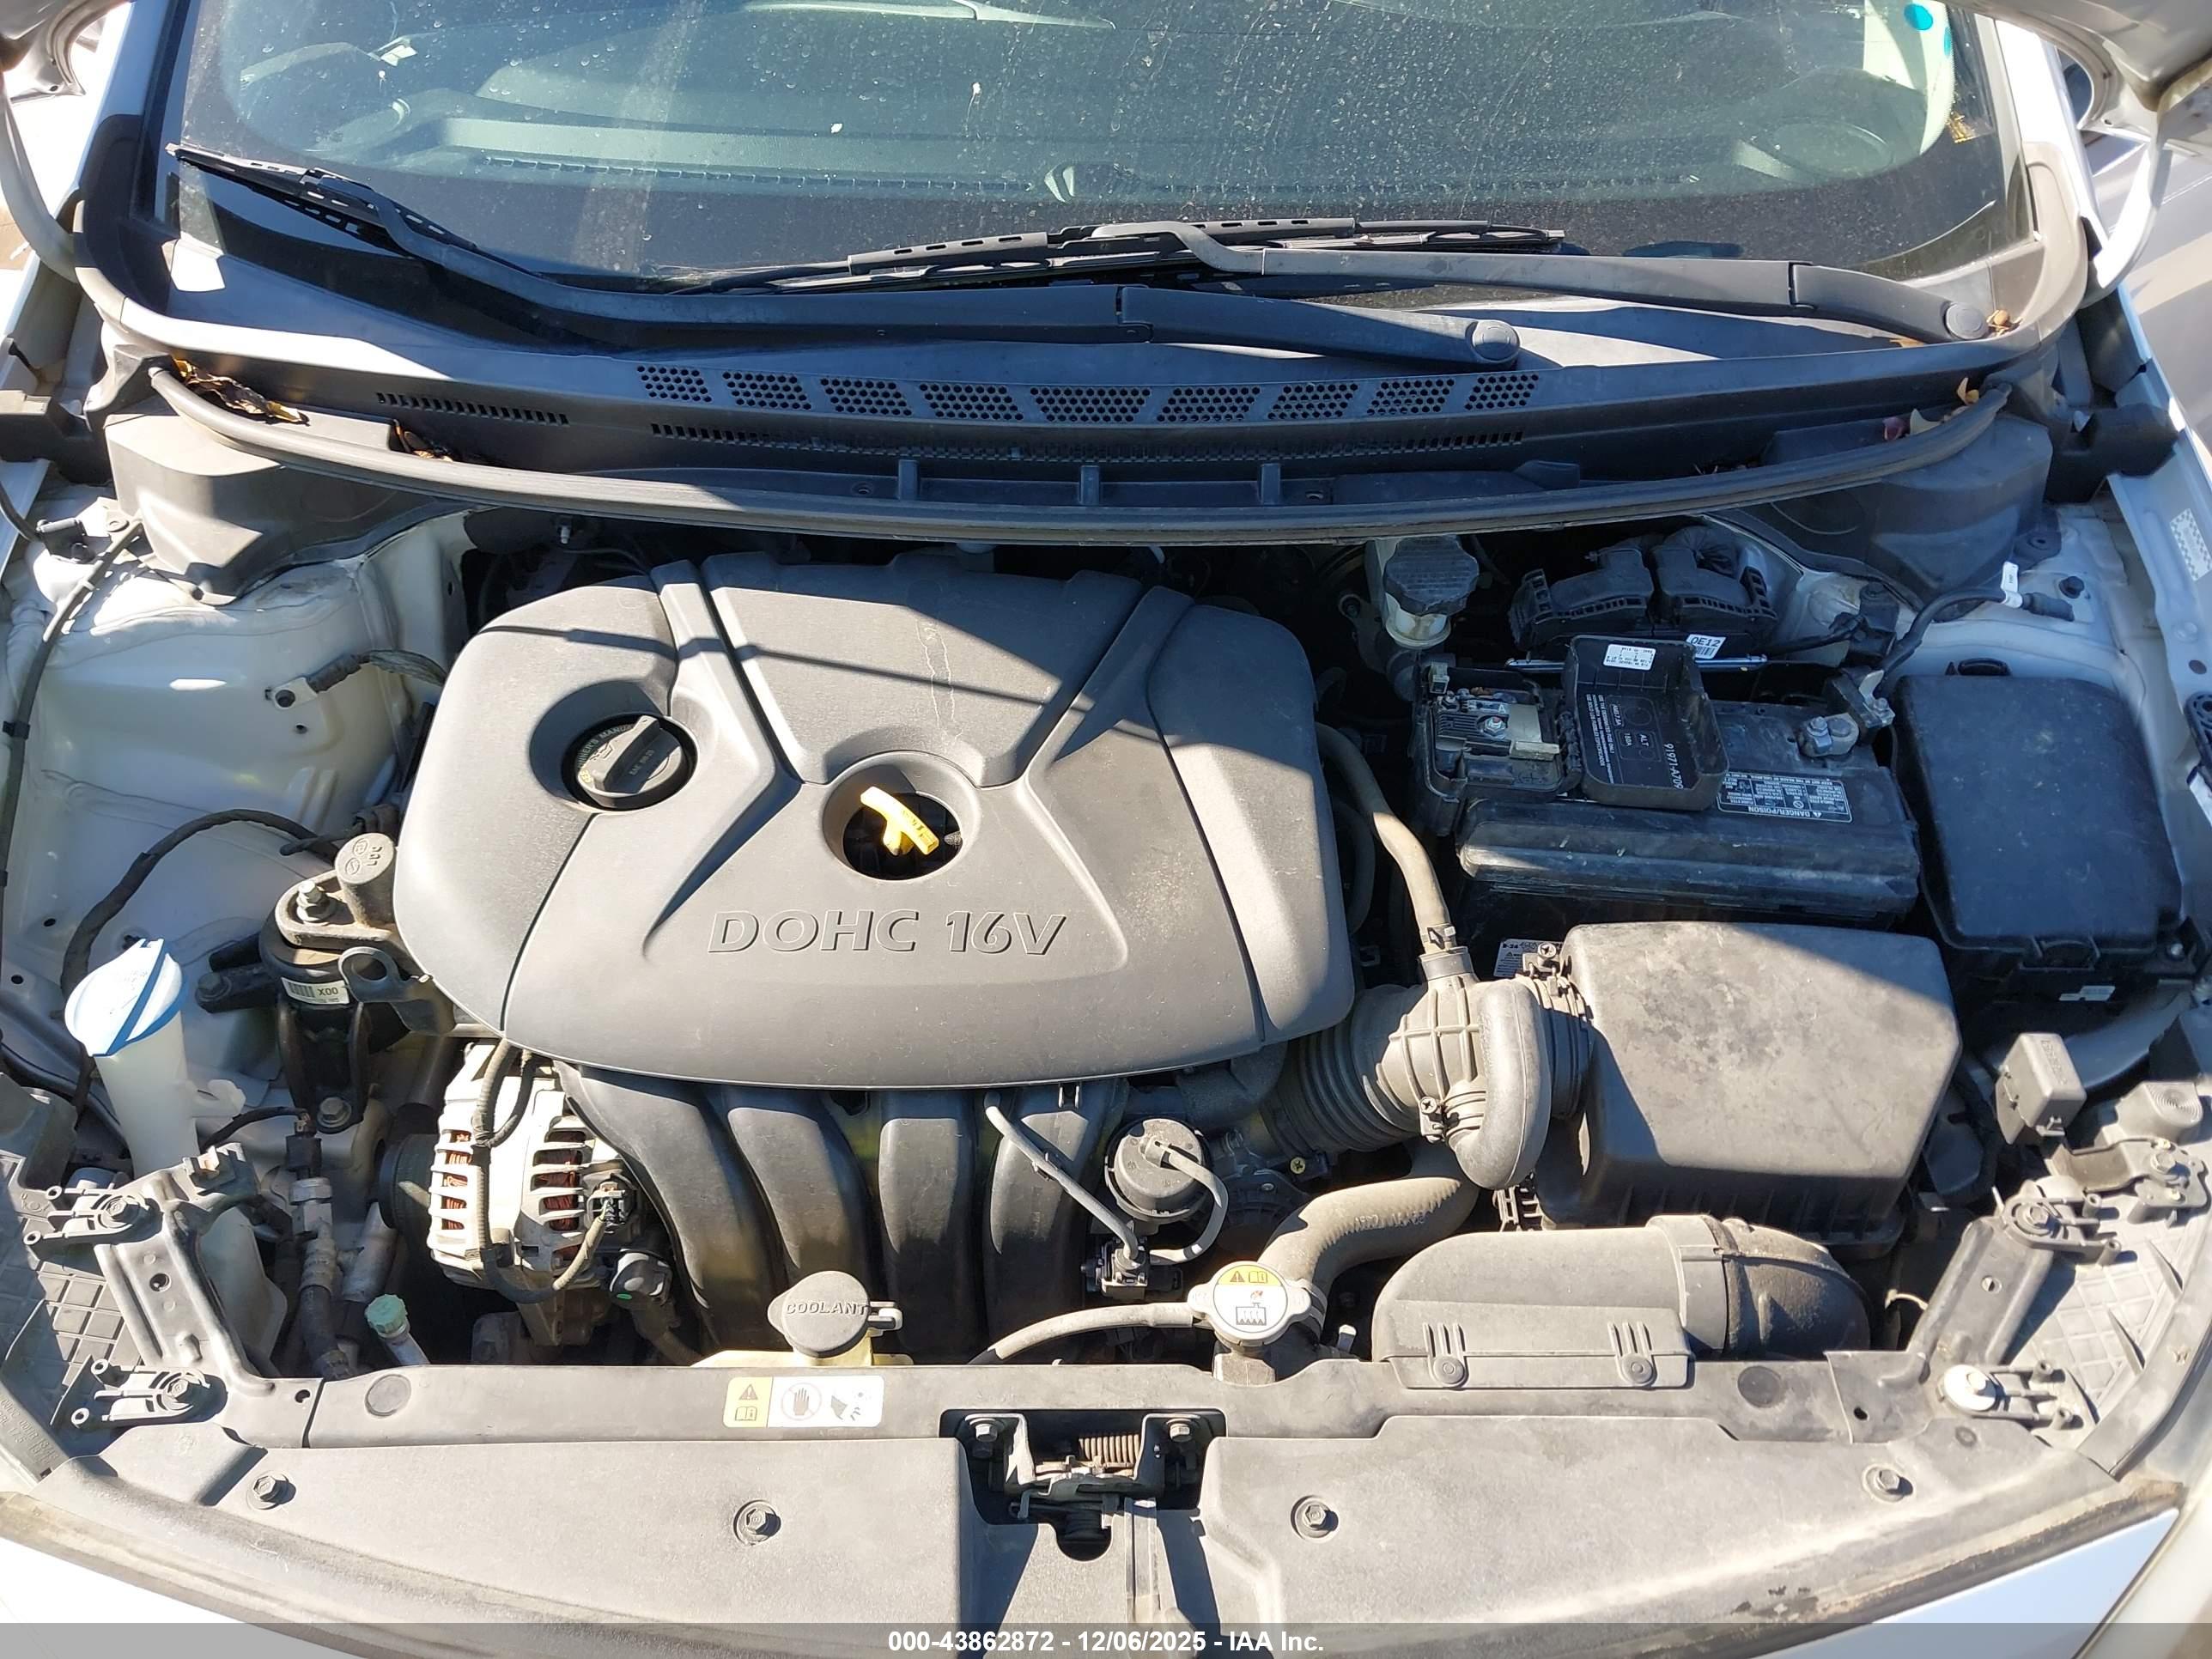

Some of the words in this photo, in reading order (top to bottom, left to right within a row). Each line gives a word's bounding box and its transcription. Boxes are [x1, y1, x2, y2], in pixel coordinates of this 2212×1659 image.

[1639, 733, 1650, 746] ALT
[1748, 805, 1810, 817] DANGER/POISON
[707, 909, 920, 953] DOHC
[945, 910, 1067, 956] 16V
[786, 1301, 867, 1316] COOLANT
